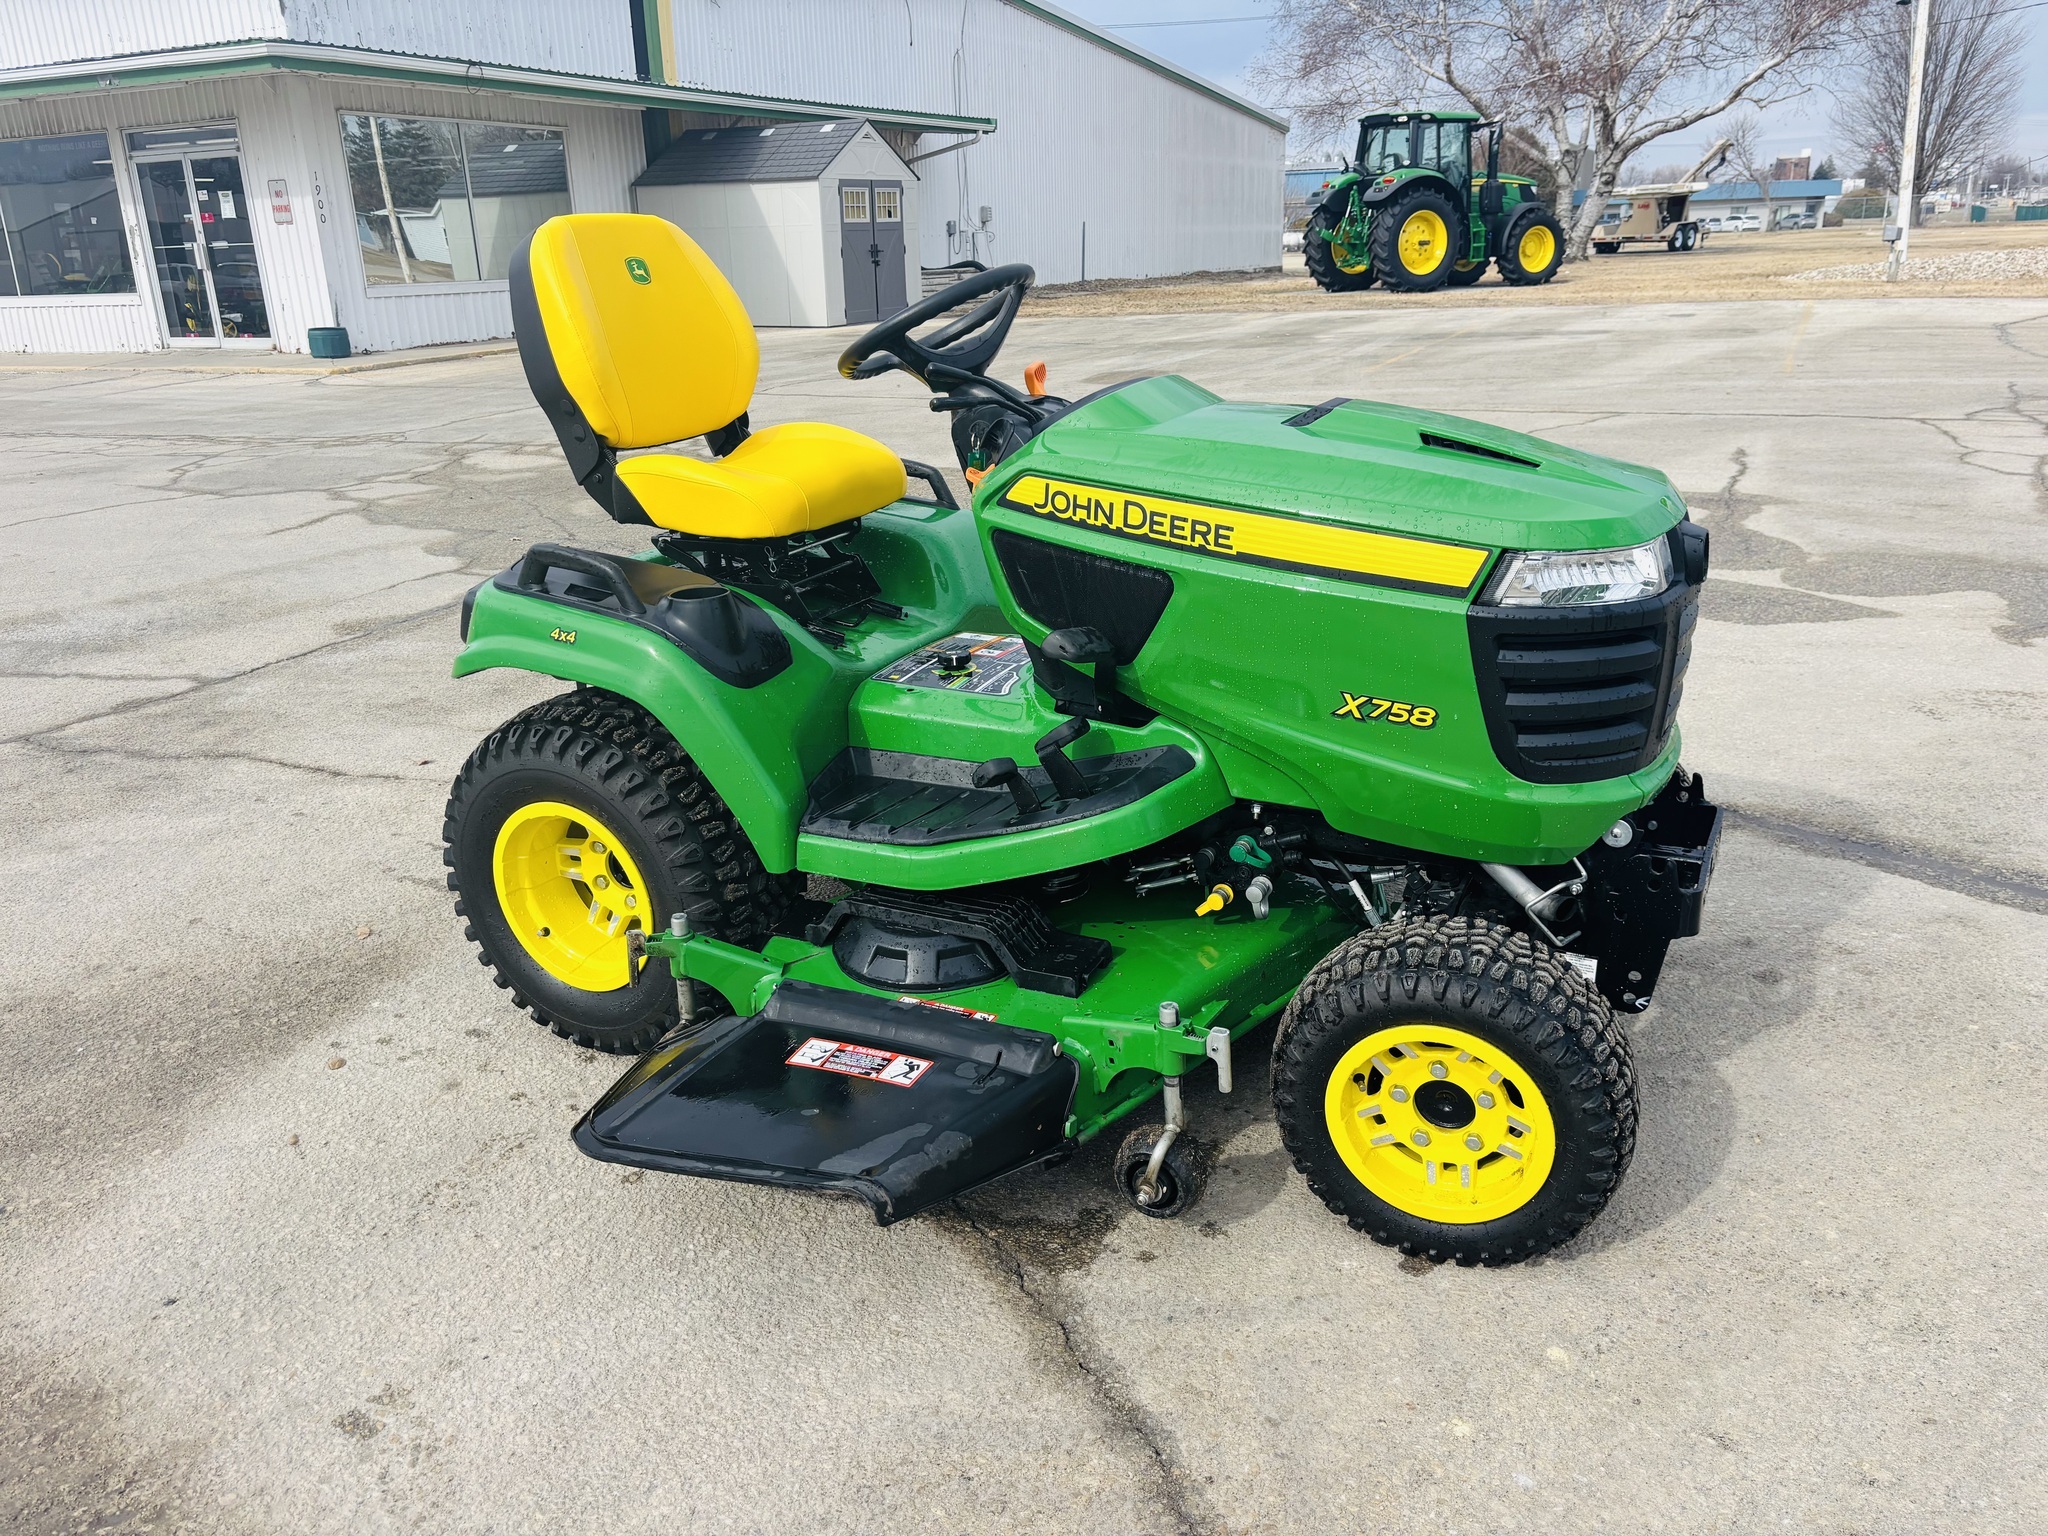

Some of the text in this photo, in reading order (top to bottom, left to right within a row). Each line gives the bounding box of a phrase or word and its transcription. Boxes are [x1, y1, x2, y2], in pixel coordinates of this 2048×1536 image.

[274, 189, 284, 199] NO
[314, 171, 326, 223] 1900
[272, 204, 291, 213] PARKING
[1033, 482, 1236, 552] JOHN DEERE
[1330, 690, 1439, 730] X758
[854, 1046, 892, 1058] DANGER
